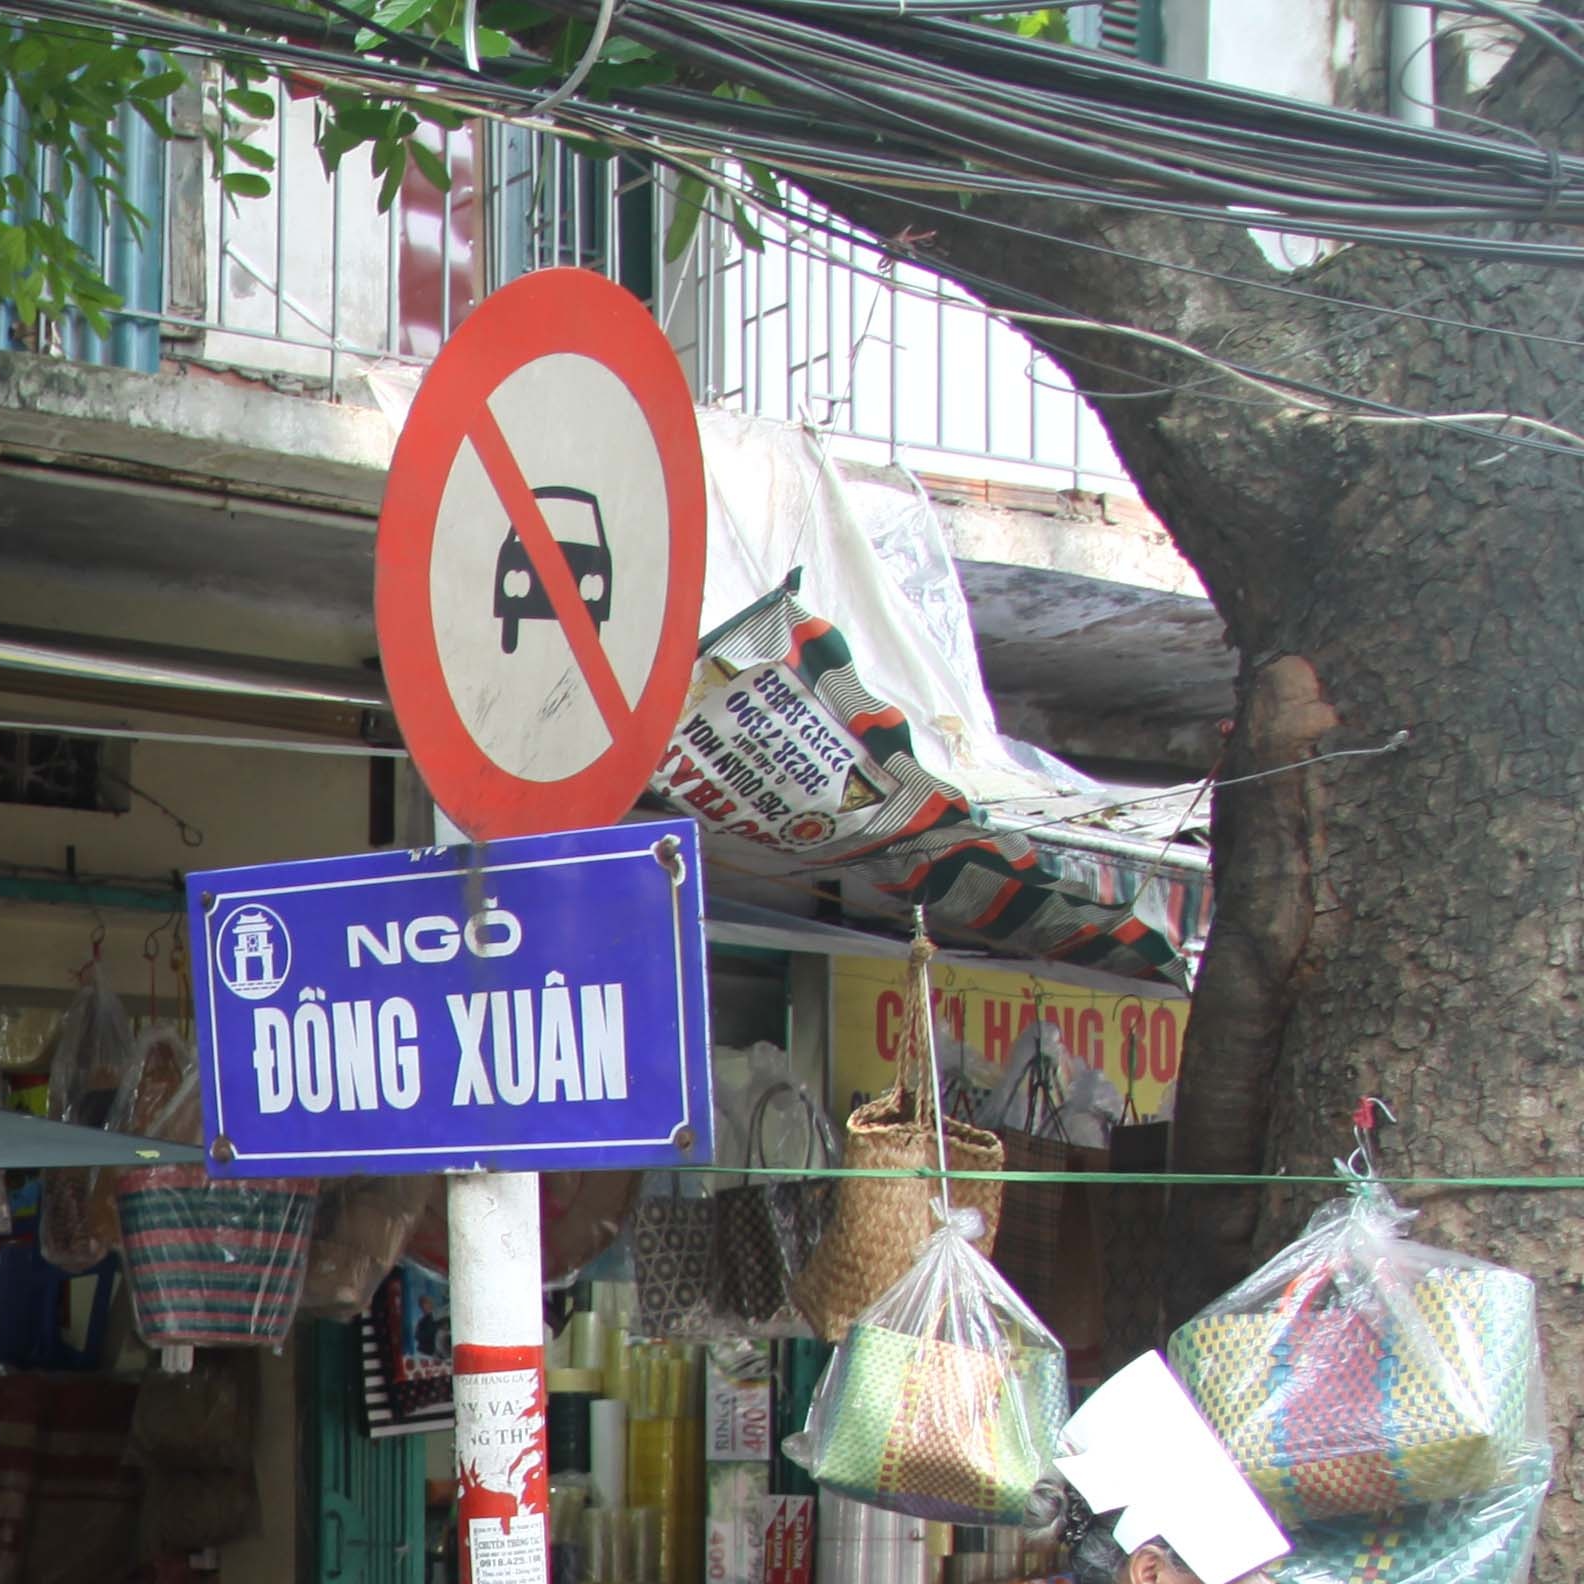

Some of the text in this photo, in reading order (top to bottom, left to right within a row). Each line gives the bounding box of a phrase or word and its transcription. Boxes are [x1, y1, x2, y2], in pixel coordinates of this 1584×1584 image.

[681, 713, 724, 757] HOA
[726, 691, 829, 796] 3828.7390
[752, 791, 792, 822] 265
[252, 970, 629, 1115] ĐỒNG XUÂN
